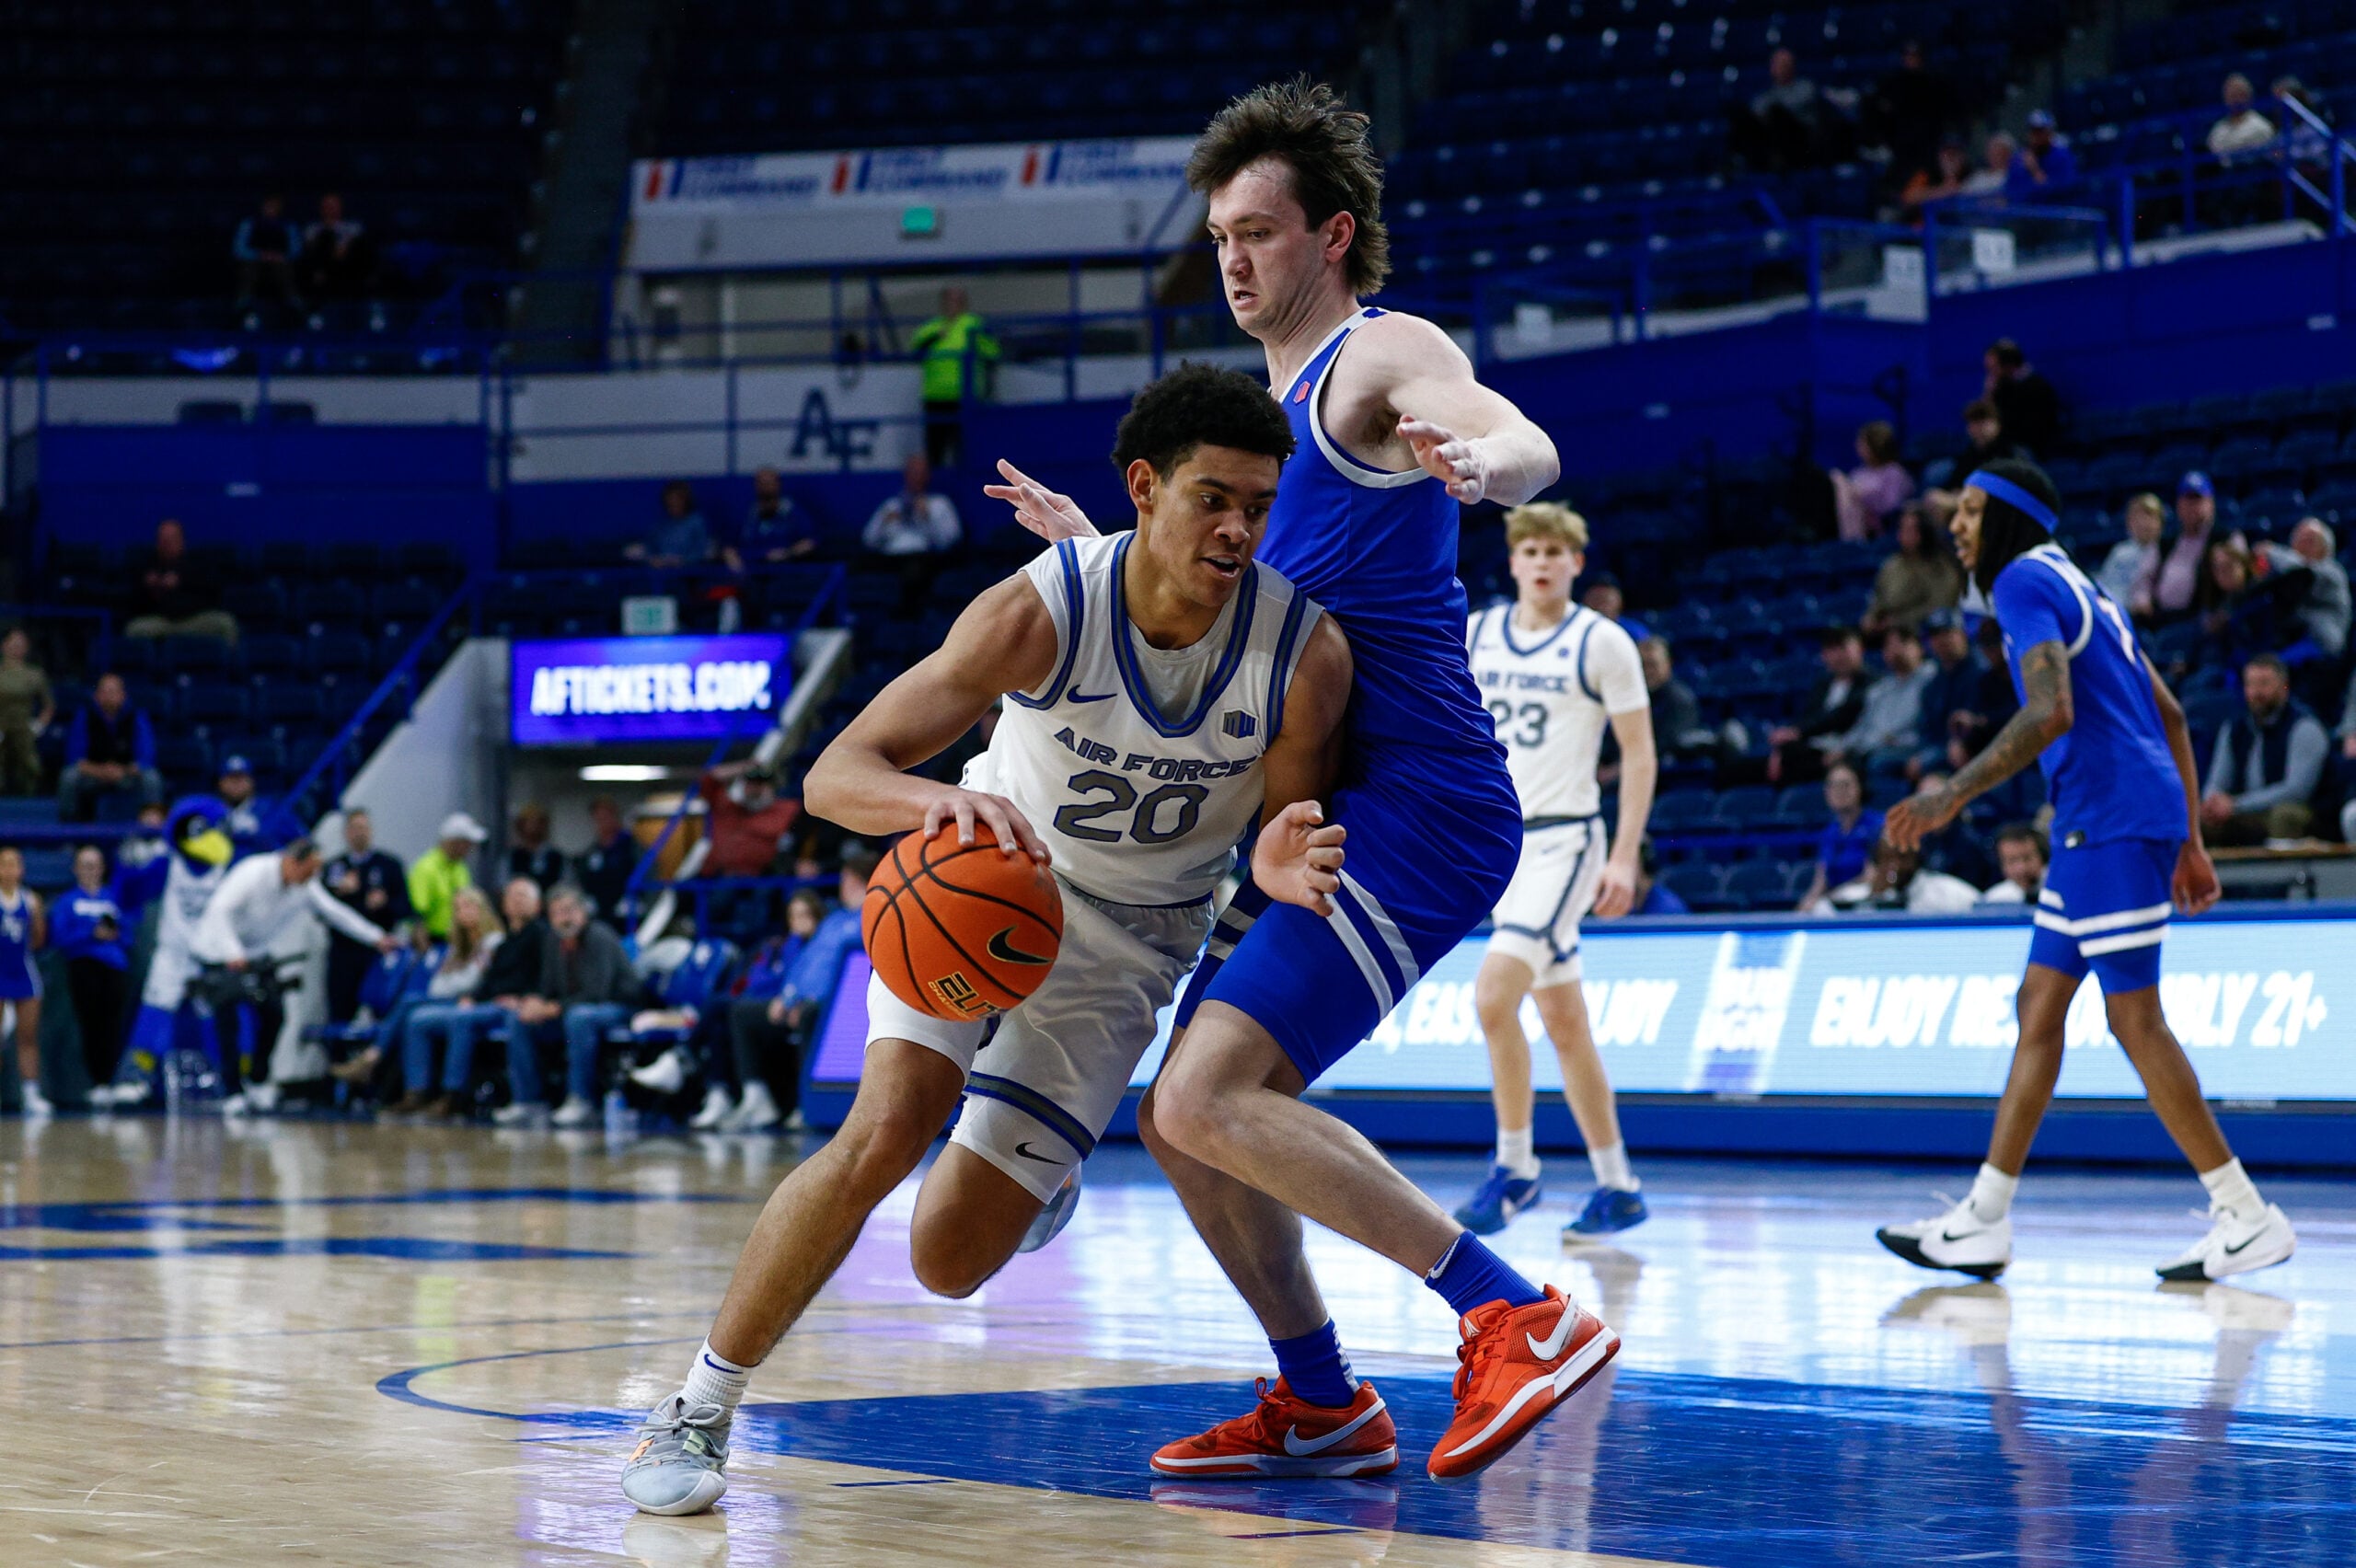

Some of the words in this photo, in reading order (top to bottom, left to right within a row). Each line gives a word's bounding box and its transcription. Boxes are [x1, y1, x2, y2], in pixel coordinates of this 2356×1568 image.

[1054, 726, 1117, 767] AIR
[1122, 753, 1259, 784] FORCE
[1488, 698, 1549, 748] 23
[1053, 769, 1210, 845] 20
[1581, 978, 1680, 1047] NJOY
[1809, 975, 1959, 1048] ENJOY
[2249, 970, 2328, 1048] 21+
